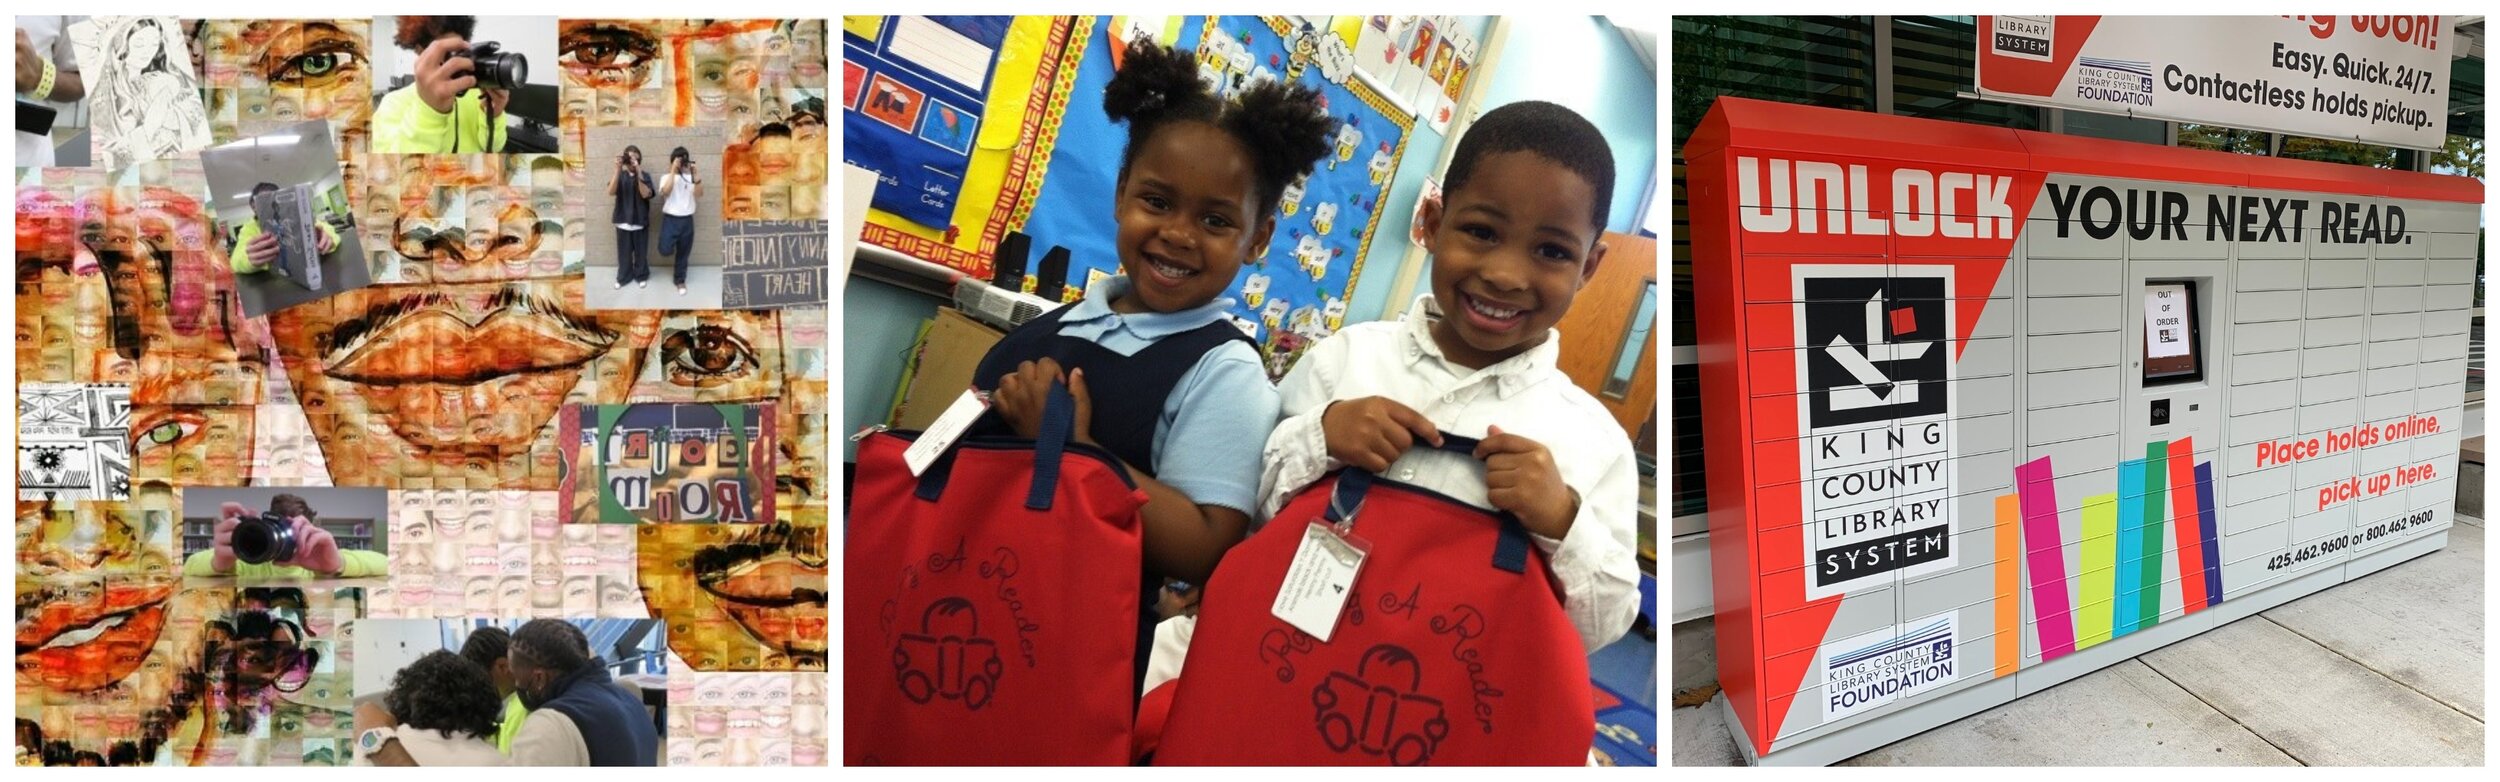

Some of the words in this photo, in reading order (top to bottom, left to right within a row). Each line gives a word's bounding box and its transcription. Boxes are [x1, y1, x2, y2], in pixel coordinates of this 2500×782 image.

[1998, 36, 2047, 52] SYSTEM
[1999, 20, 2047, 35] LIBRARY
[2078, 67, 2102, 78] KING
[2106, 71, 2141, 83] COUNTY
[2078, 77, 2110, 88] LIBRARY
[2113, 81, 2141, 91] SYSTEM
[2272, 42, 2328, 79] Easy.
[2333, 52, 2393, 86] Quick.
[2394, 65, 2436, 95] 24/7.
[2077, 86, 2153, 107] FOUNDATION
[2163, 64, 2306, 110] Contactless
[2312, 87, 2368, 118] holds
[2371, 99, 2433, 131] pickup.
[2045, 182, 2189, 241] YOUR
[2206, 193, 2309, 243] NEXT
[2320, 201, 2412, 245] READ.
[2157, 290, 2172, 299] OUT
[2161, 304, 2171, 312] OF
[2156, 317, 2180, 326] ORDER
[1822, 423, 1940, 460] KING
[2256, 438, 2320, 468] Place
[2326, 424, 2379, 454] holds
[2384, 414, 2441, 442] online,
[1822, 460, 1941, 499] COUNTY
[2318, 477, 2361, 512] pick
[2367, 474, 2391, 496] up
[2396, 463, 2437, 487] here.
[1825, 499, 1941, 539] LIBRARY
[1826, 532, 1942, 575] SYSTEM
[2267, 535, 2349, 571] 425.462.9600
[2351, 533, 2364, 546] or
[2366, 517, 2407, 541] 800.462
[2409, 509, 2434, 527] 9600
[1333, 583, 1344, 595] 4
[1379, 582, 1421, 621] A
[1430, 604, 1504, 735] Reader
[1829, 663, 1866, 682] KING
[1873, 644, 1931, 668] COUNTY
[1830, 670, 1881, 694] LIBRARY
[1885, 656, 1930, 677] SYSTEM
[1831, 660, 1952, 713] FOUNDATION
